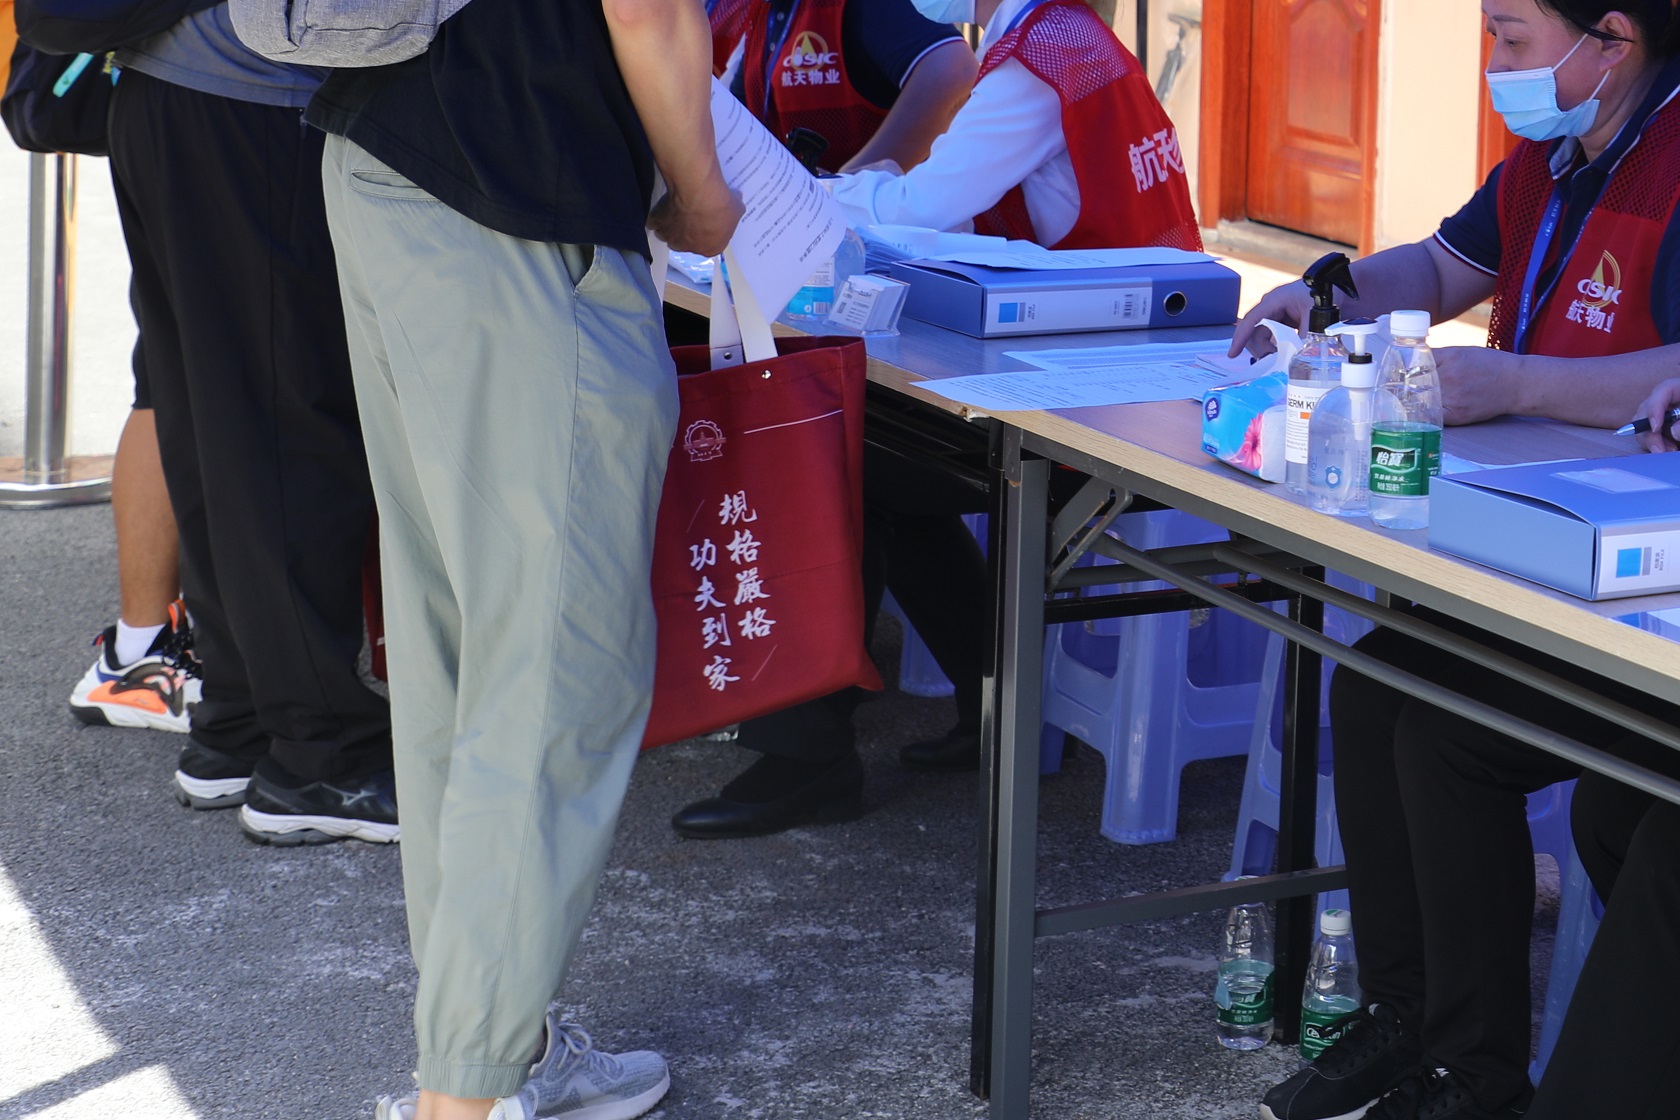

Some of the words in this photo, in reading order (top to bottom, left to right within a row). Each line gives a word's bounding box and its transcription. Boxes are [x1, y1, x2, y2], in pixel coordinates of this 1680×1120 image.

[781, 68, 840, 87] 航天物业
[1376, 451, 1405, 467] 怡寶
[689, 538, 741, 692] 功夫到家
